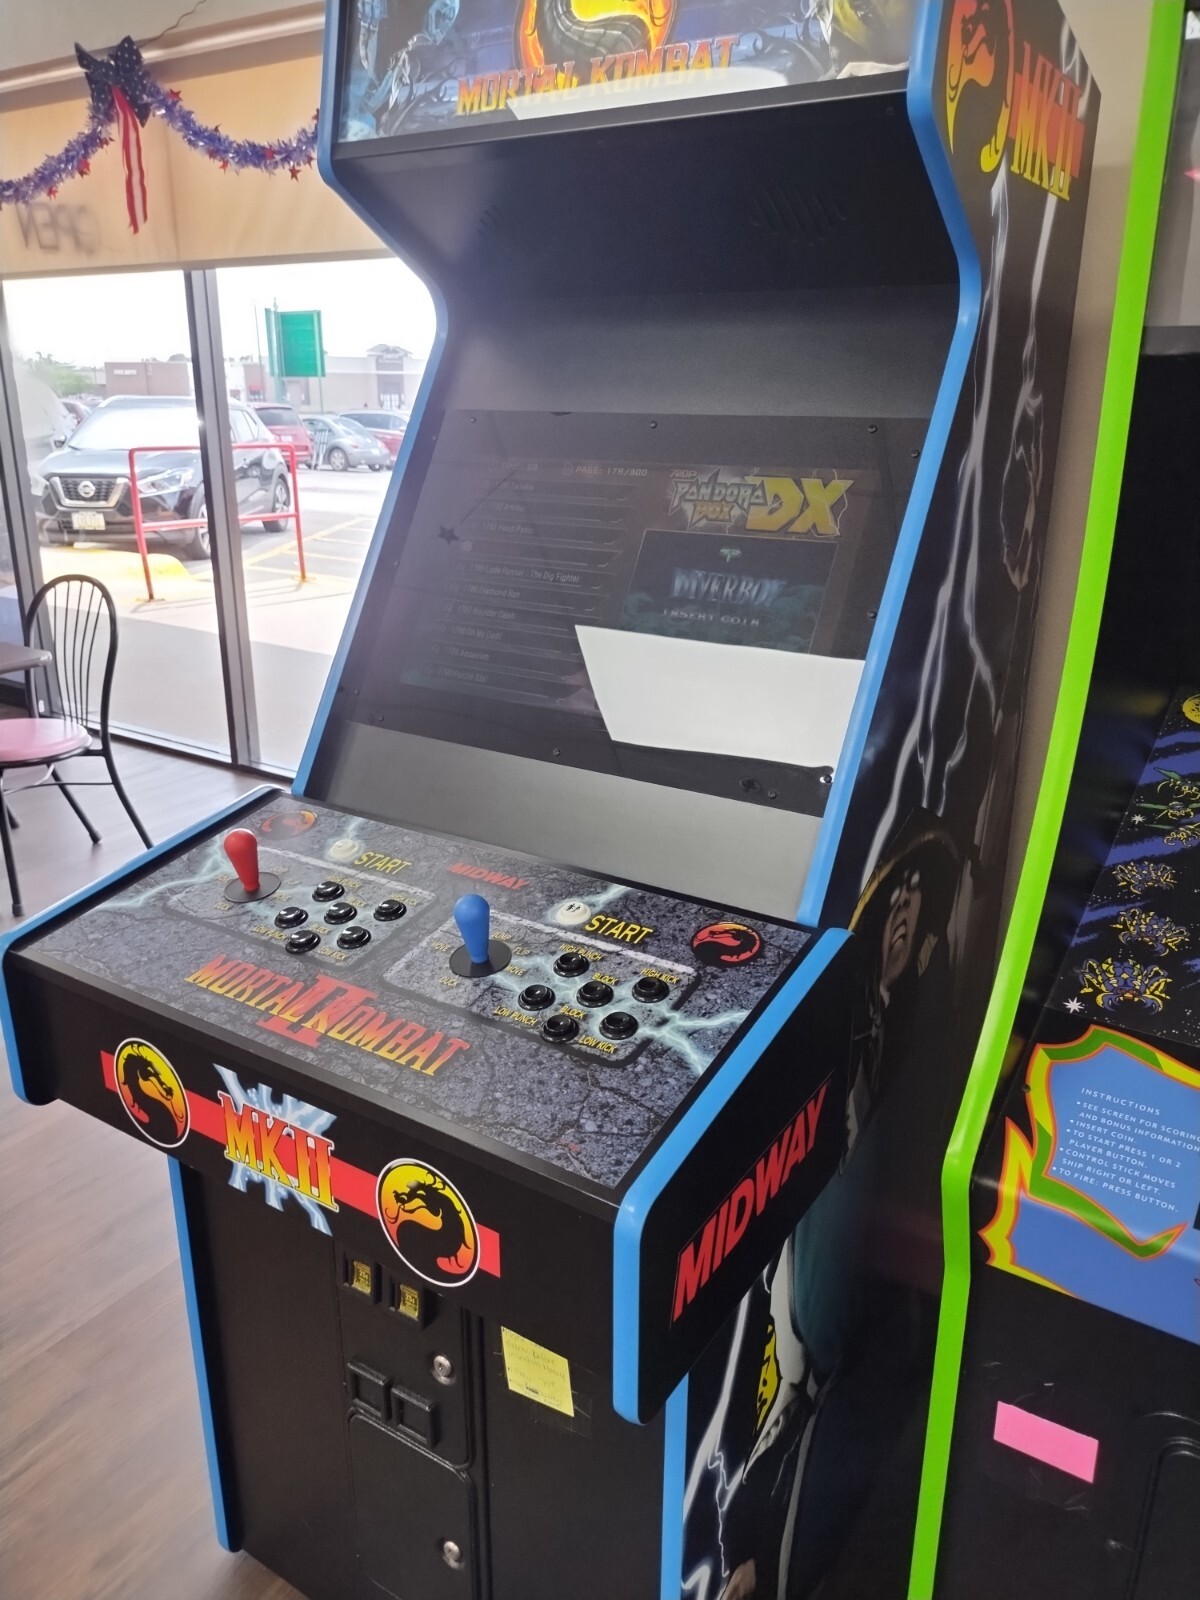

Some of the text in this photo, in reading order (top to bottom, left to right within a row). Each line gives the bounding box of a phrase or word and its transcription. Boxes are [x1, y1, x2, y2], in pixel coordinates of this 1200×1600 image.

[455, 35, 740, 117] MORTAL KOMBAT
[607, 466, 648, 477] 179/300
[668, 468, 769, 516] PANDORA
[687, 501, 736, 530] BOX
[744, 475, 854, 536] DX
[530, 569, 542, 579] The
[543, 571, 554, 582] Dig
[555, 572, 580, 583] Fighter
[663, 608, 760, 628] INSERT COIN
[353, 851, 412, 875] START
[448, 862, 529, 891] MIDWAY
[584, 914, 654, 944] START
[513, 946, 532, 956] FLIP
[559, 943, 604, 962] HIGH PUNCH
[438, 976, 461, 987] DUCK
[505, 964, 526, 977] MOVE
[591, 972, 619, 985] BLOCK
[640, 967, 681, 985] HIGH KICK
[184, 953, 304, 1024] MORTAL
[302, 997, 471, 1077] KOMBAT
[493, 1006, 538, 1026] LOW PUNCH
[560, 1003, 587, 1020] BLOCK
[578, 1034, 617, 1054] LOW KICK
[1081, 1088, 1160, 1115] INSTRUCTIONS
[1079, 1112, 1098, 1121] AND
[1100, 1117, 1131, 1131] BONUS
[1082, 1102, 1098, 1111] SEE
[1102, 1108, 1136, 1122] SCREEN
[1139, 1119, 1157, 1129] FOR
[1076, 1120, 1137, 1143] INSERT COIN.
[1069, 1139, 1148, 1168] PLAYER BUTTON.
[1073, 1130, 1084, 1138] TO
[1088, 1133, 1116, 1147] START
[1119, 1143, 1147, 1157] PRESS
[1159, 1157, 1172, 1165] OR
[1062, 1158, 1161, 1195] SHIP RIGHT OR LEFT.
[1066, 1148, 1176, 1188] CONTROL STICK MOVES
[673, 1082, 828, 1322] MIDWAY
[1059, 1168, 1179, 1212] TO FIRE: PRESS BUTTON.
